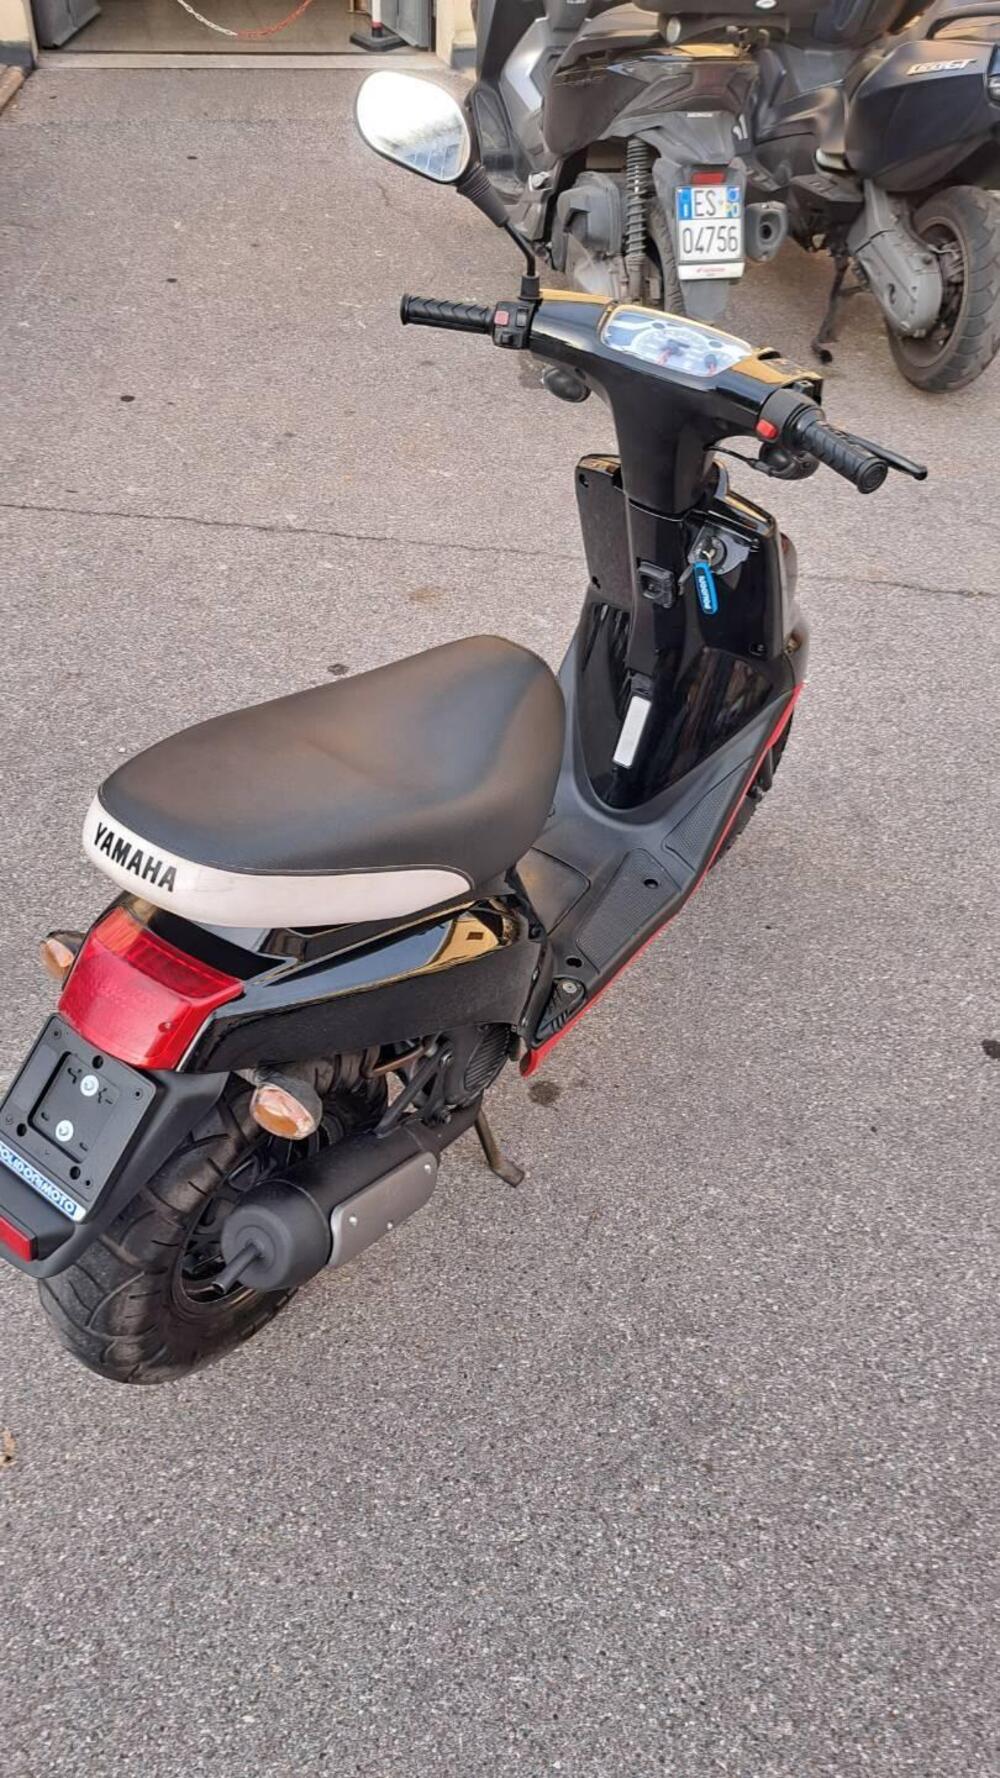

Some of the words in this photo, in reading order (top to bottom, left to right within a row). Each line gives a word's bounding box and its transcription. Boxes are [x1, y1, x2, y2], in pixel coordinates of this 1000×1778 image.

[694, 190, 716, 217] ES
[683, 226, 738, 254] 04756
[94, 822, 177, 893] YAMAHA
[0, 1143, 75, 1214] OLIDORIMOTO
